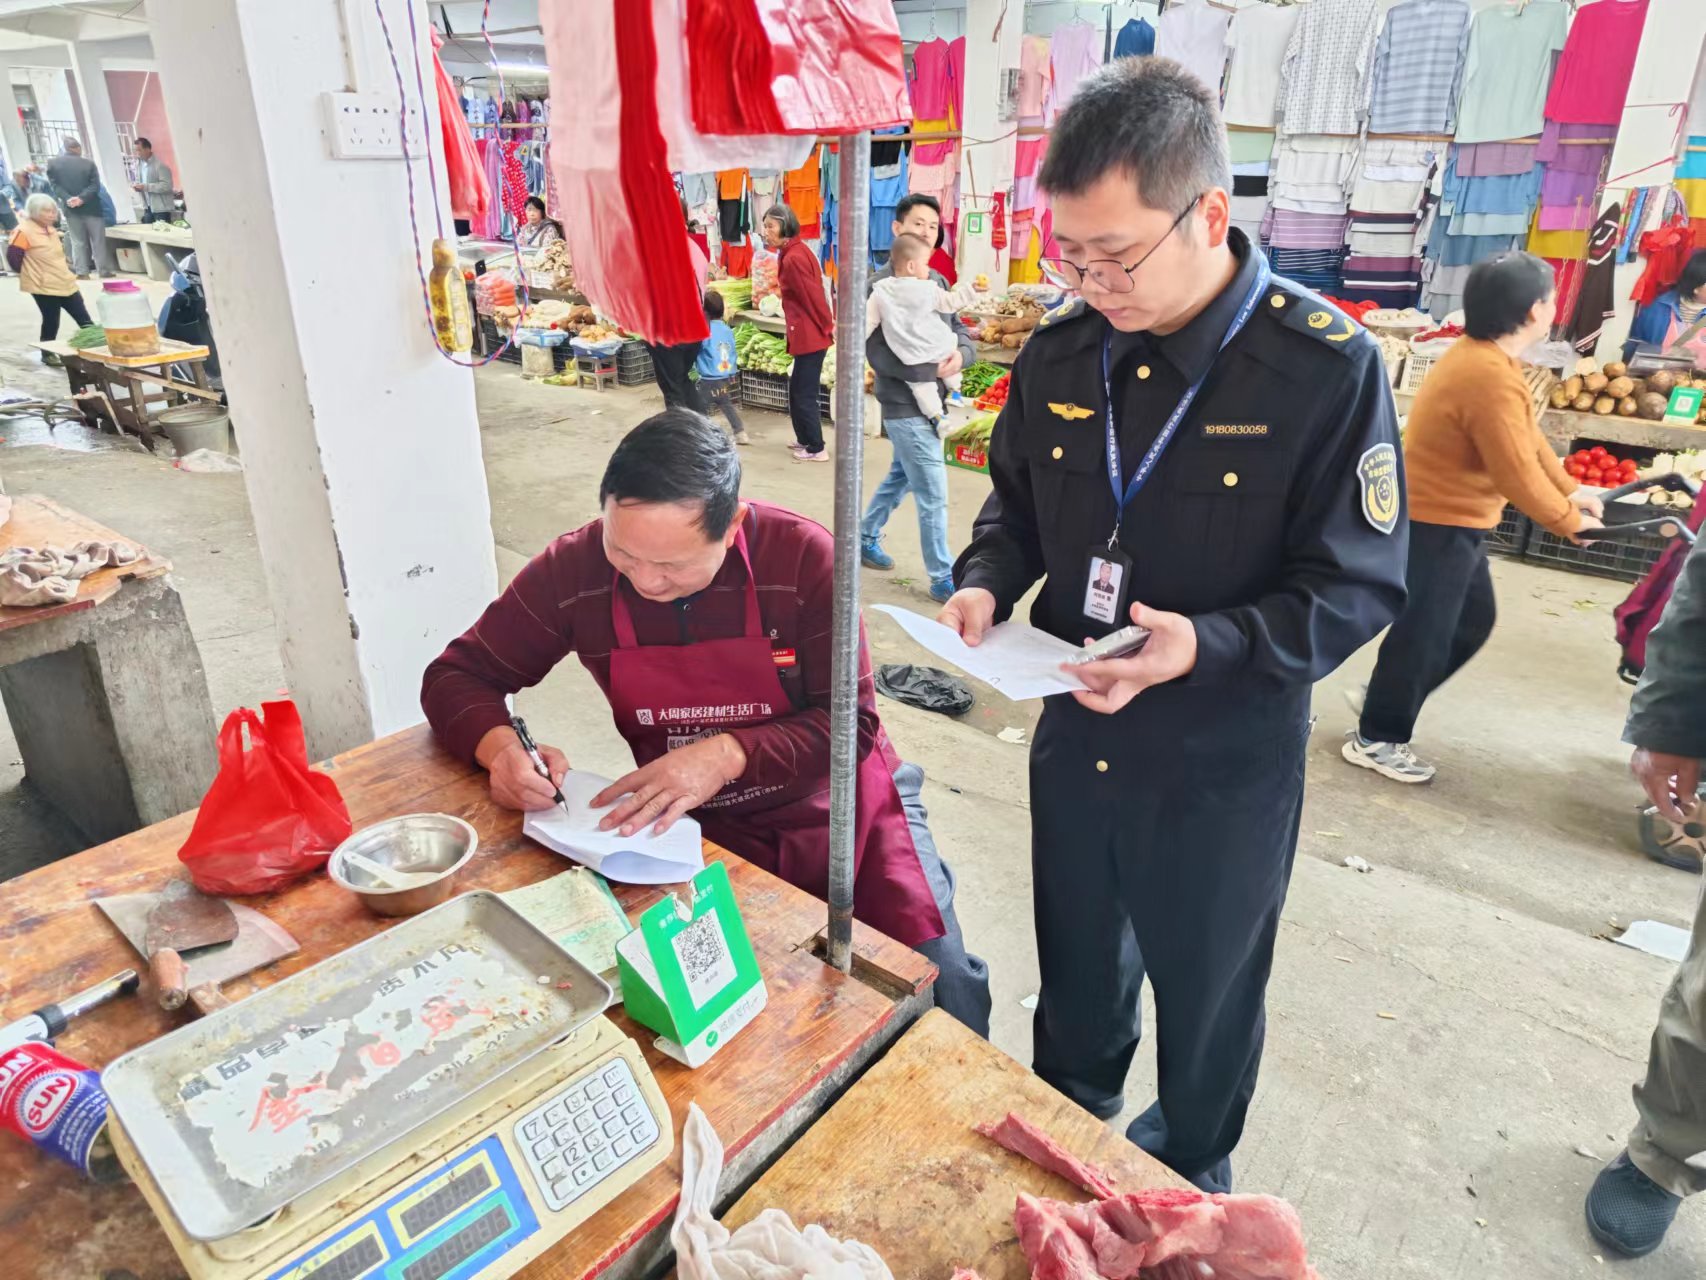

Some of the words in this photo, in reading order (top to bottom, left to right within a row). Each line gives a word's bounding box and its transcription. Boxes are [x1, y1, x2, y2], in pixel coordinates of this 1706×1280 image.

[1204, 424, 1268, 435] 19180830058
[658, 703, 772, 721] 大周家居建材生活广场
[28, 1077, 69, 1124] SUN
[531, 1118, 543, 1137] 7
[569, 1147, 580, 1161] 2
